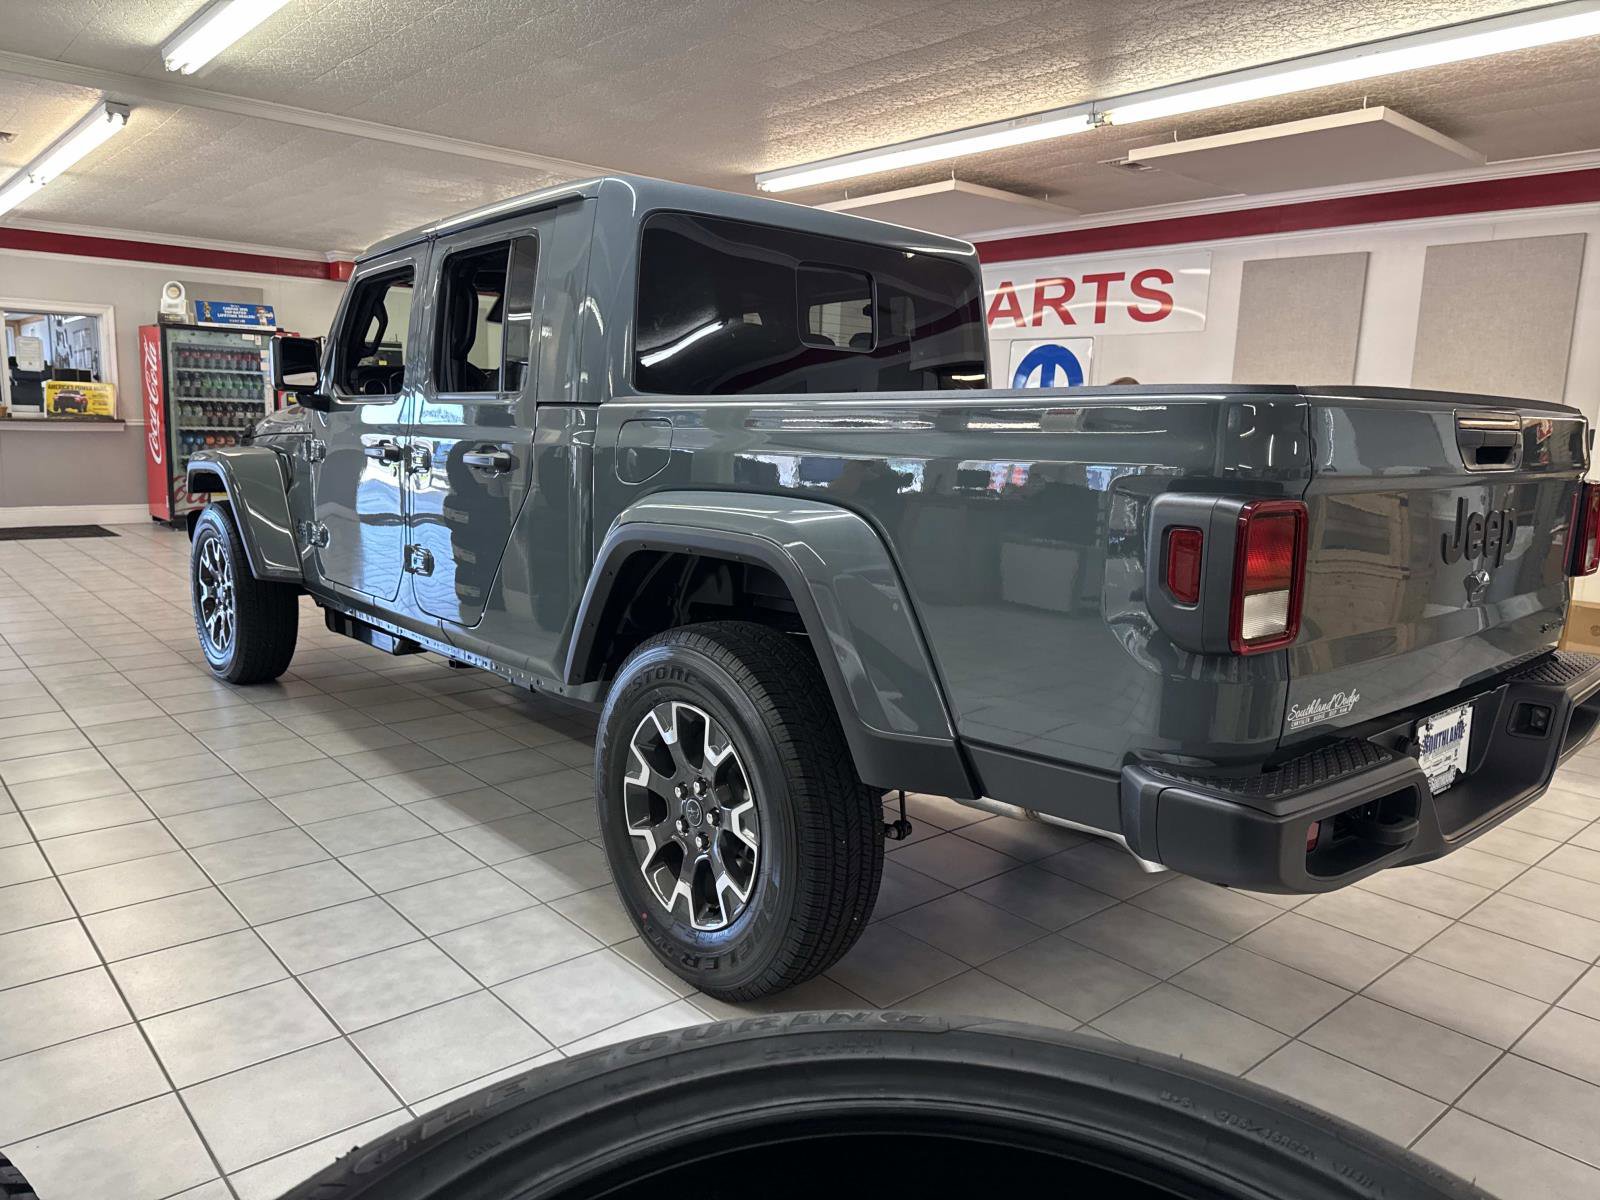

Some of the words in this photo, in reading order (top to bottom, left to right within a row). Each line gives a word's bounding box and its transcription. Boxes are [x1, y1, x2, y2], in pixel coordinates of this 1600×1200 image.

[987, 268, 1174, 328] ARTS
[1441, 496, 1518, 568] Jeep
[1287, 693, 1336, 721] Southland
[1335, 688, 1361, 712] Dodge
[1422, 720, 1464, 755] SOUTHLAND
